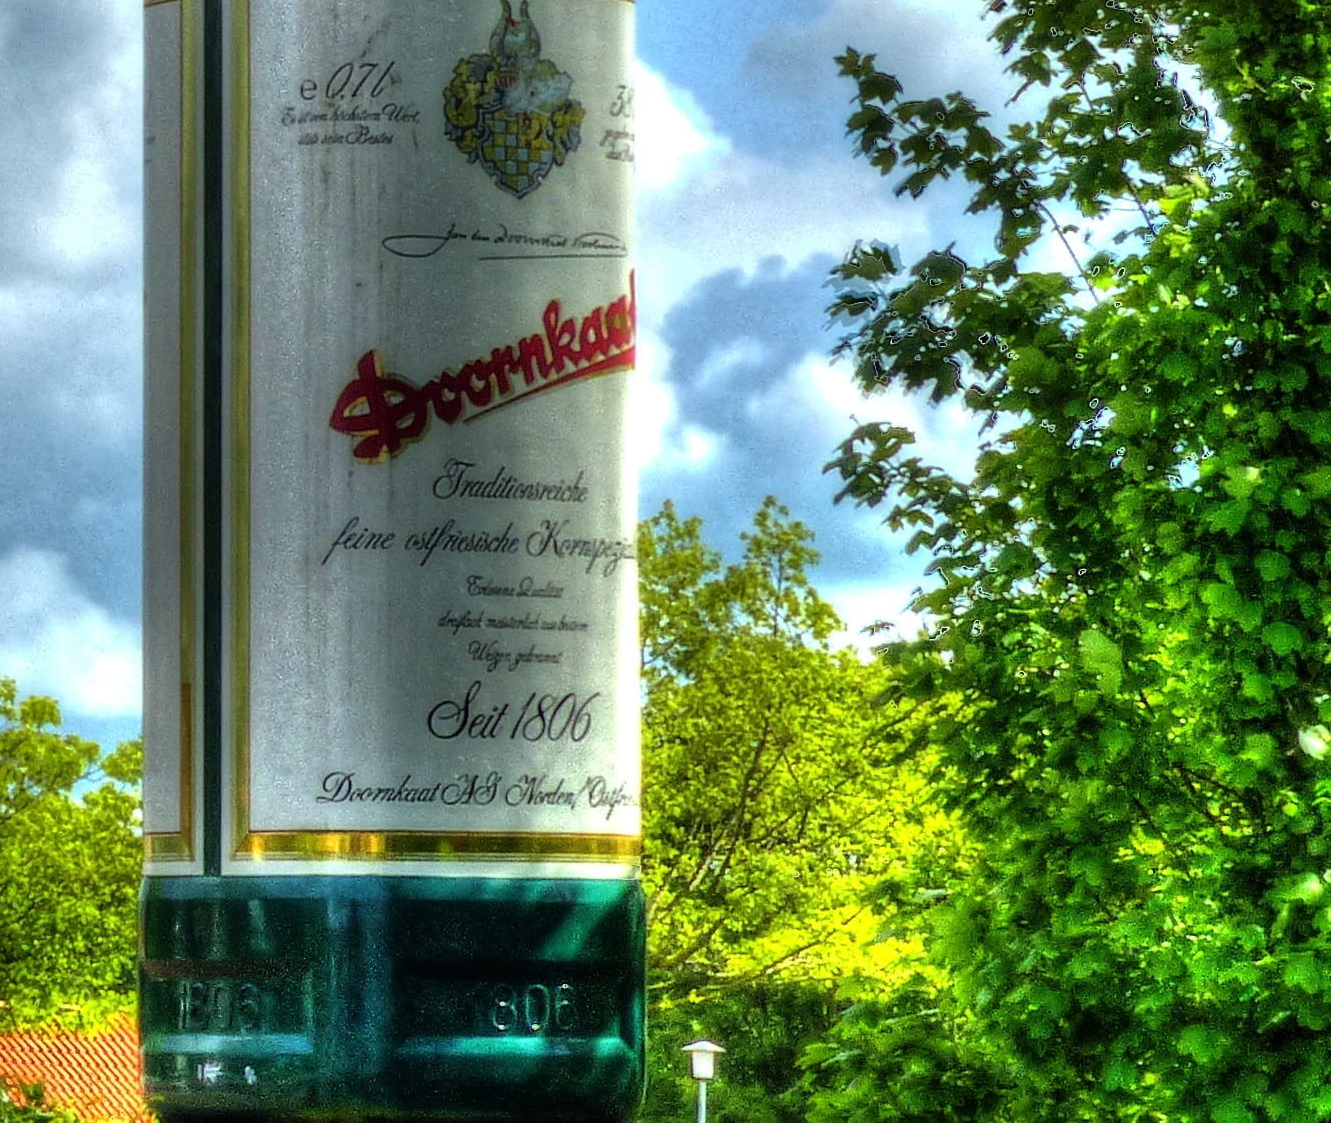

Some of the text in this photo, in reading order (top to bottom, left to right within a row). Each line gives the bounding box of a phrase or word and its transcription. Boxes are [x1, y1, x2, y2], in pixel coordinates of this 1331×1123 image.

[432, 458, 589, 503] Traditionsreiche
[321, 516, 636, 578] feine ostfriesische Kornspezi
[427, 679, 601, 743] Seit 1806
[315, 771, 441, 805] Doornkaat
